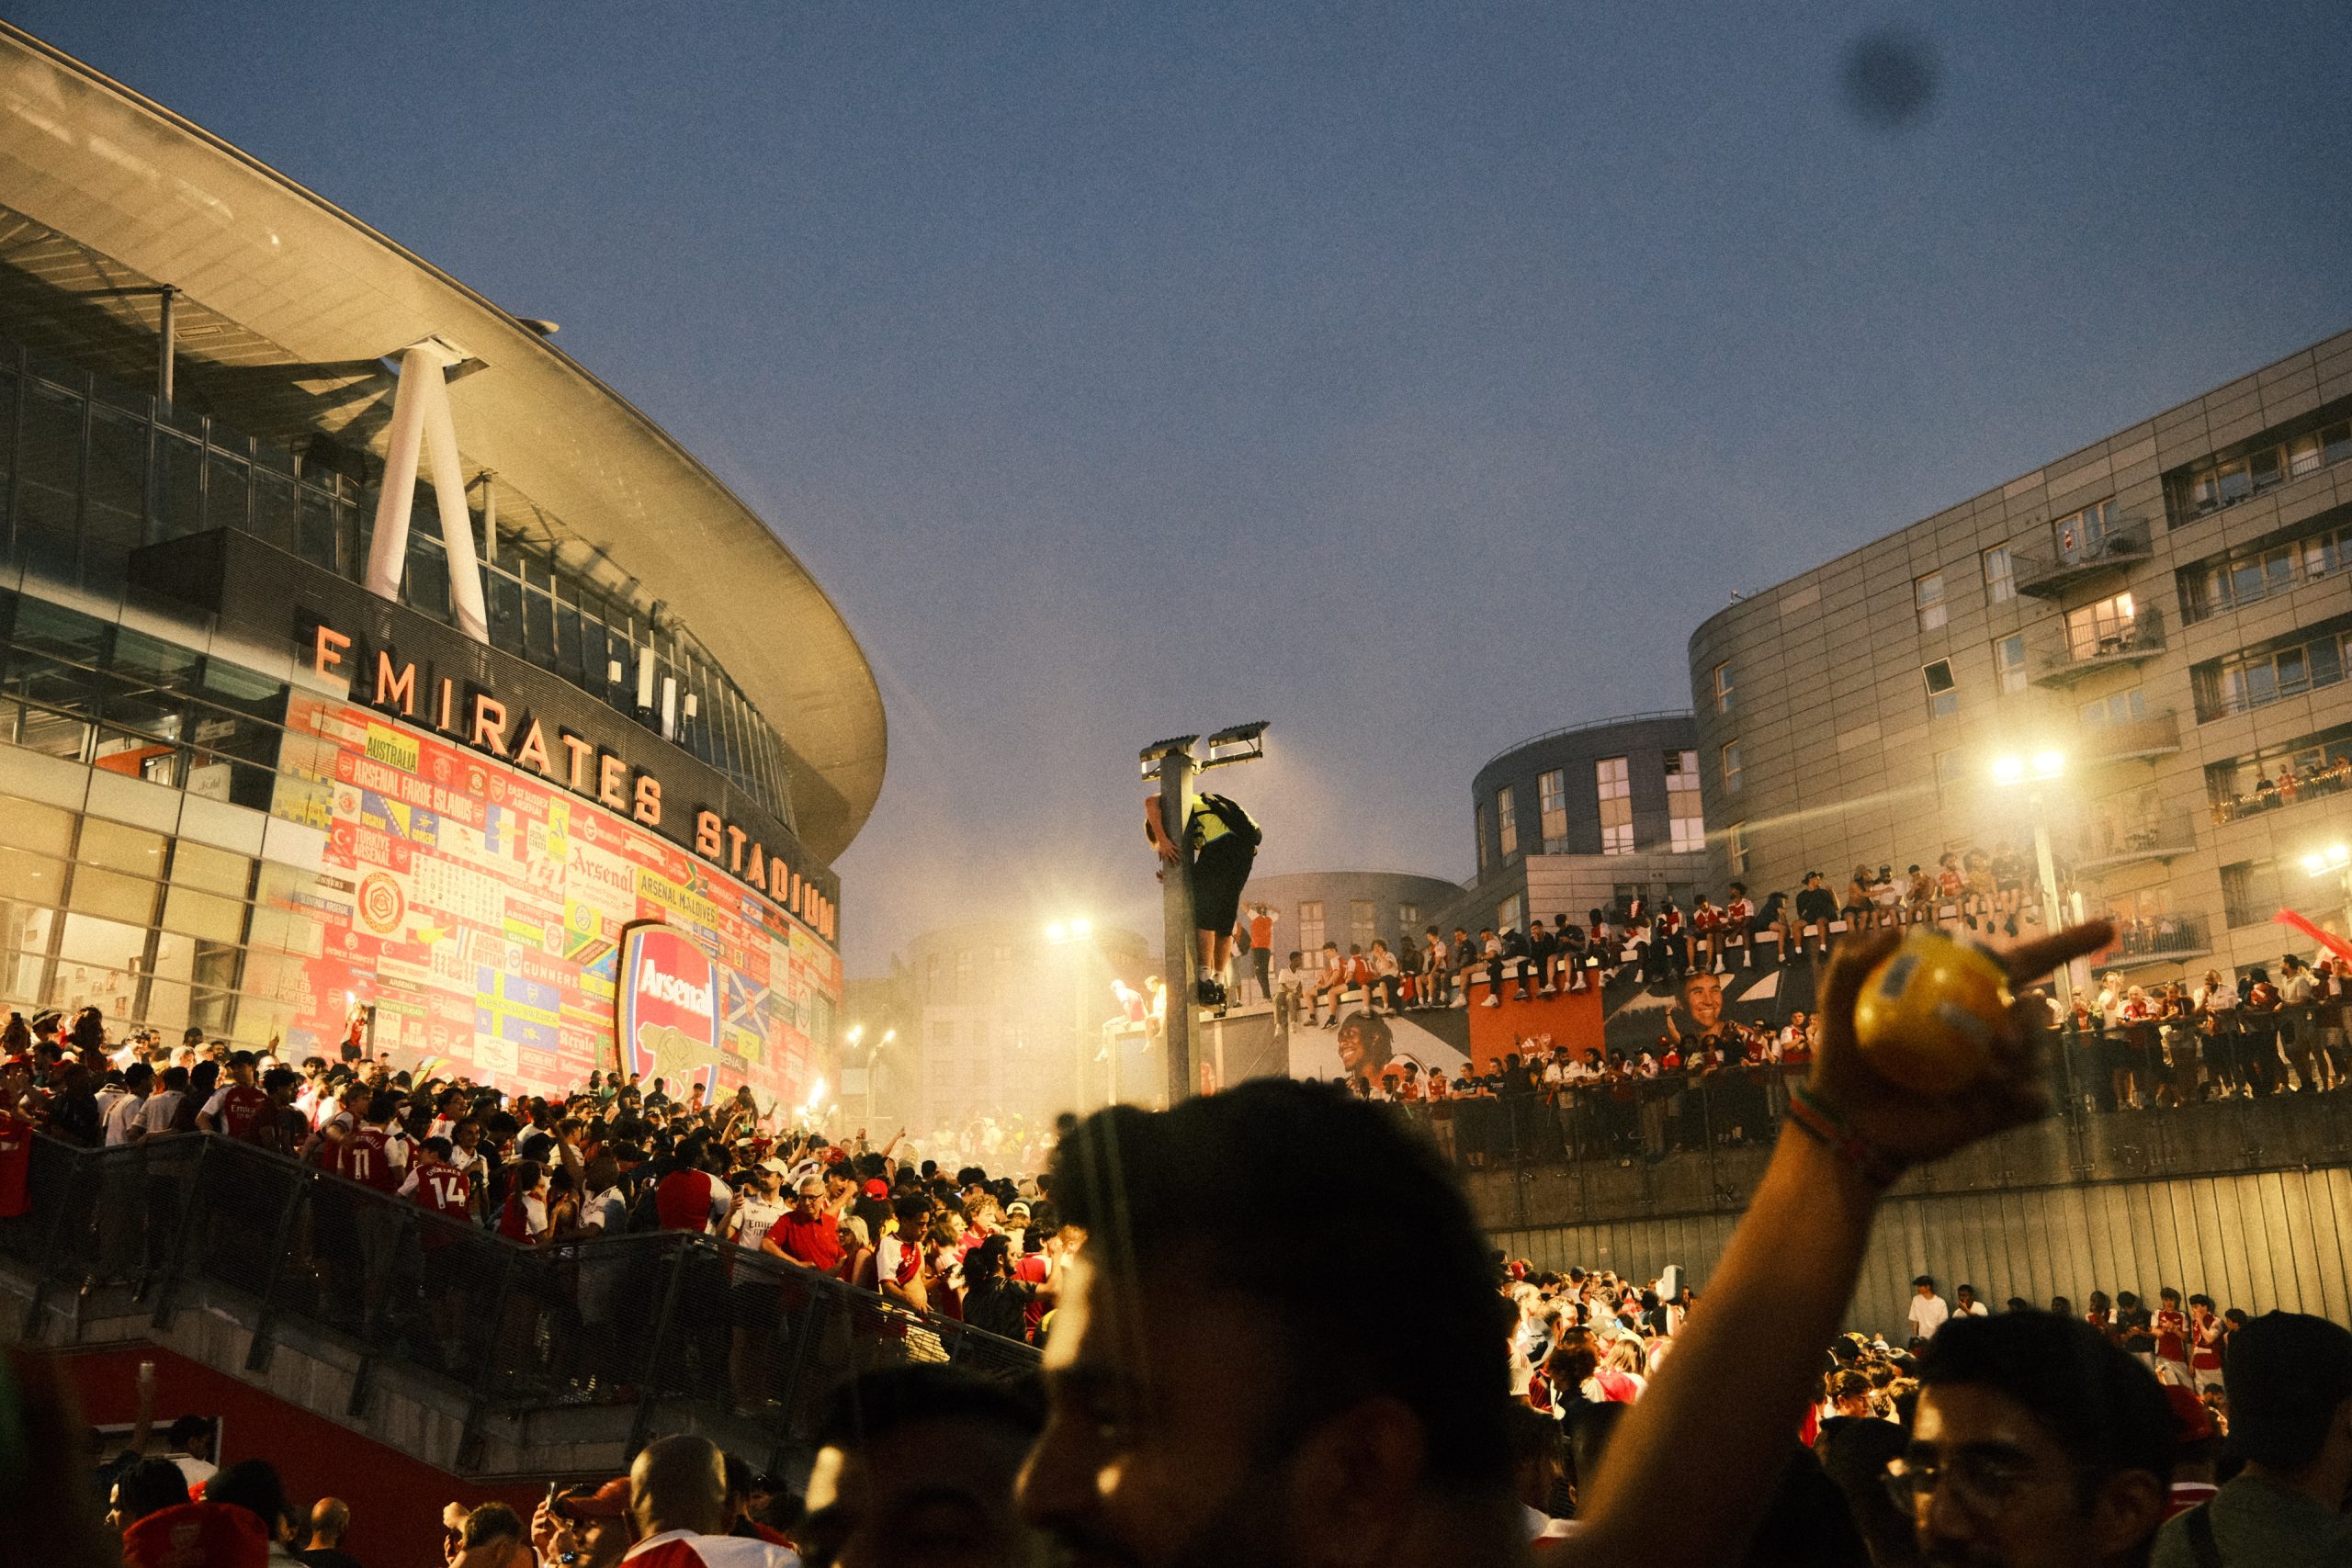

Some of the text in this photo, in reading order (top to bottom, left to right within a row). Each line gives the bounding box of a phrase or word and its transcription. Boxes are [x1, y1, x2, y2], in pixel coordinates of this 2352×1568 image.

[366, 736, 417, 773] AUSTRALIA
[315, 625, 835, 942] EMIRATES STADIUM
[353, 758, 473, 823] ARSENAL FAROE ISLANDS
[507, 784, 548, 809] EAST SUSSEX
[512, 798, 543, 818] ARSENAL
[353, 844, 391, 867] ARSENAL
[569, 846, 636, 895] Arsenal
[640, 875, 677, 906] ARSENAL
[679, 893, 717, 925] MALDIVES
[506, 910, 544, 928] ARSENAL
[475, 932, 506, 957] ARSENAL
[508, 932, 538, 950] GHANA
[523, 960, 580, 989] GUNNERS
[639, 958, 713, 1018] Arsenal
[480, 995, 521, 1015] ARSENAL
[523, 1008, 559, 1024] SWEDEN
[719, 1052, 745, 1072] SENAL
[352, 1148, 370, 1179] 11
[430, 1177, 467, 1210] 14
